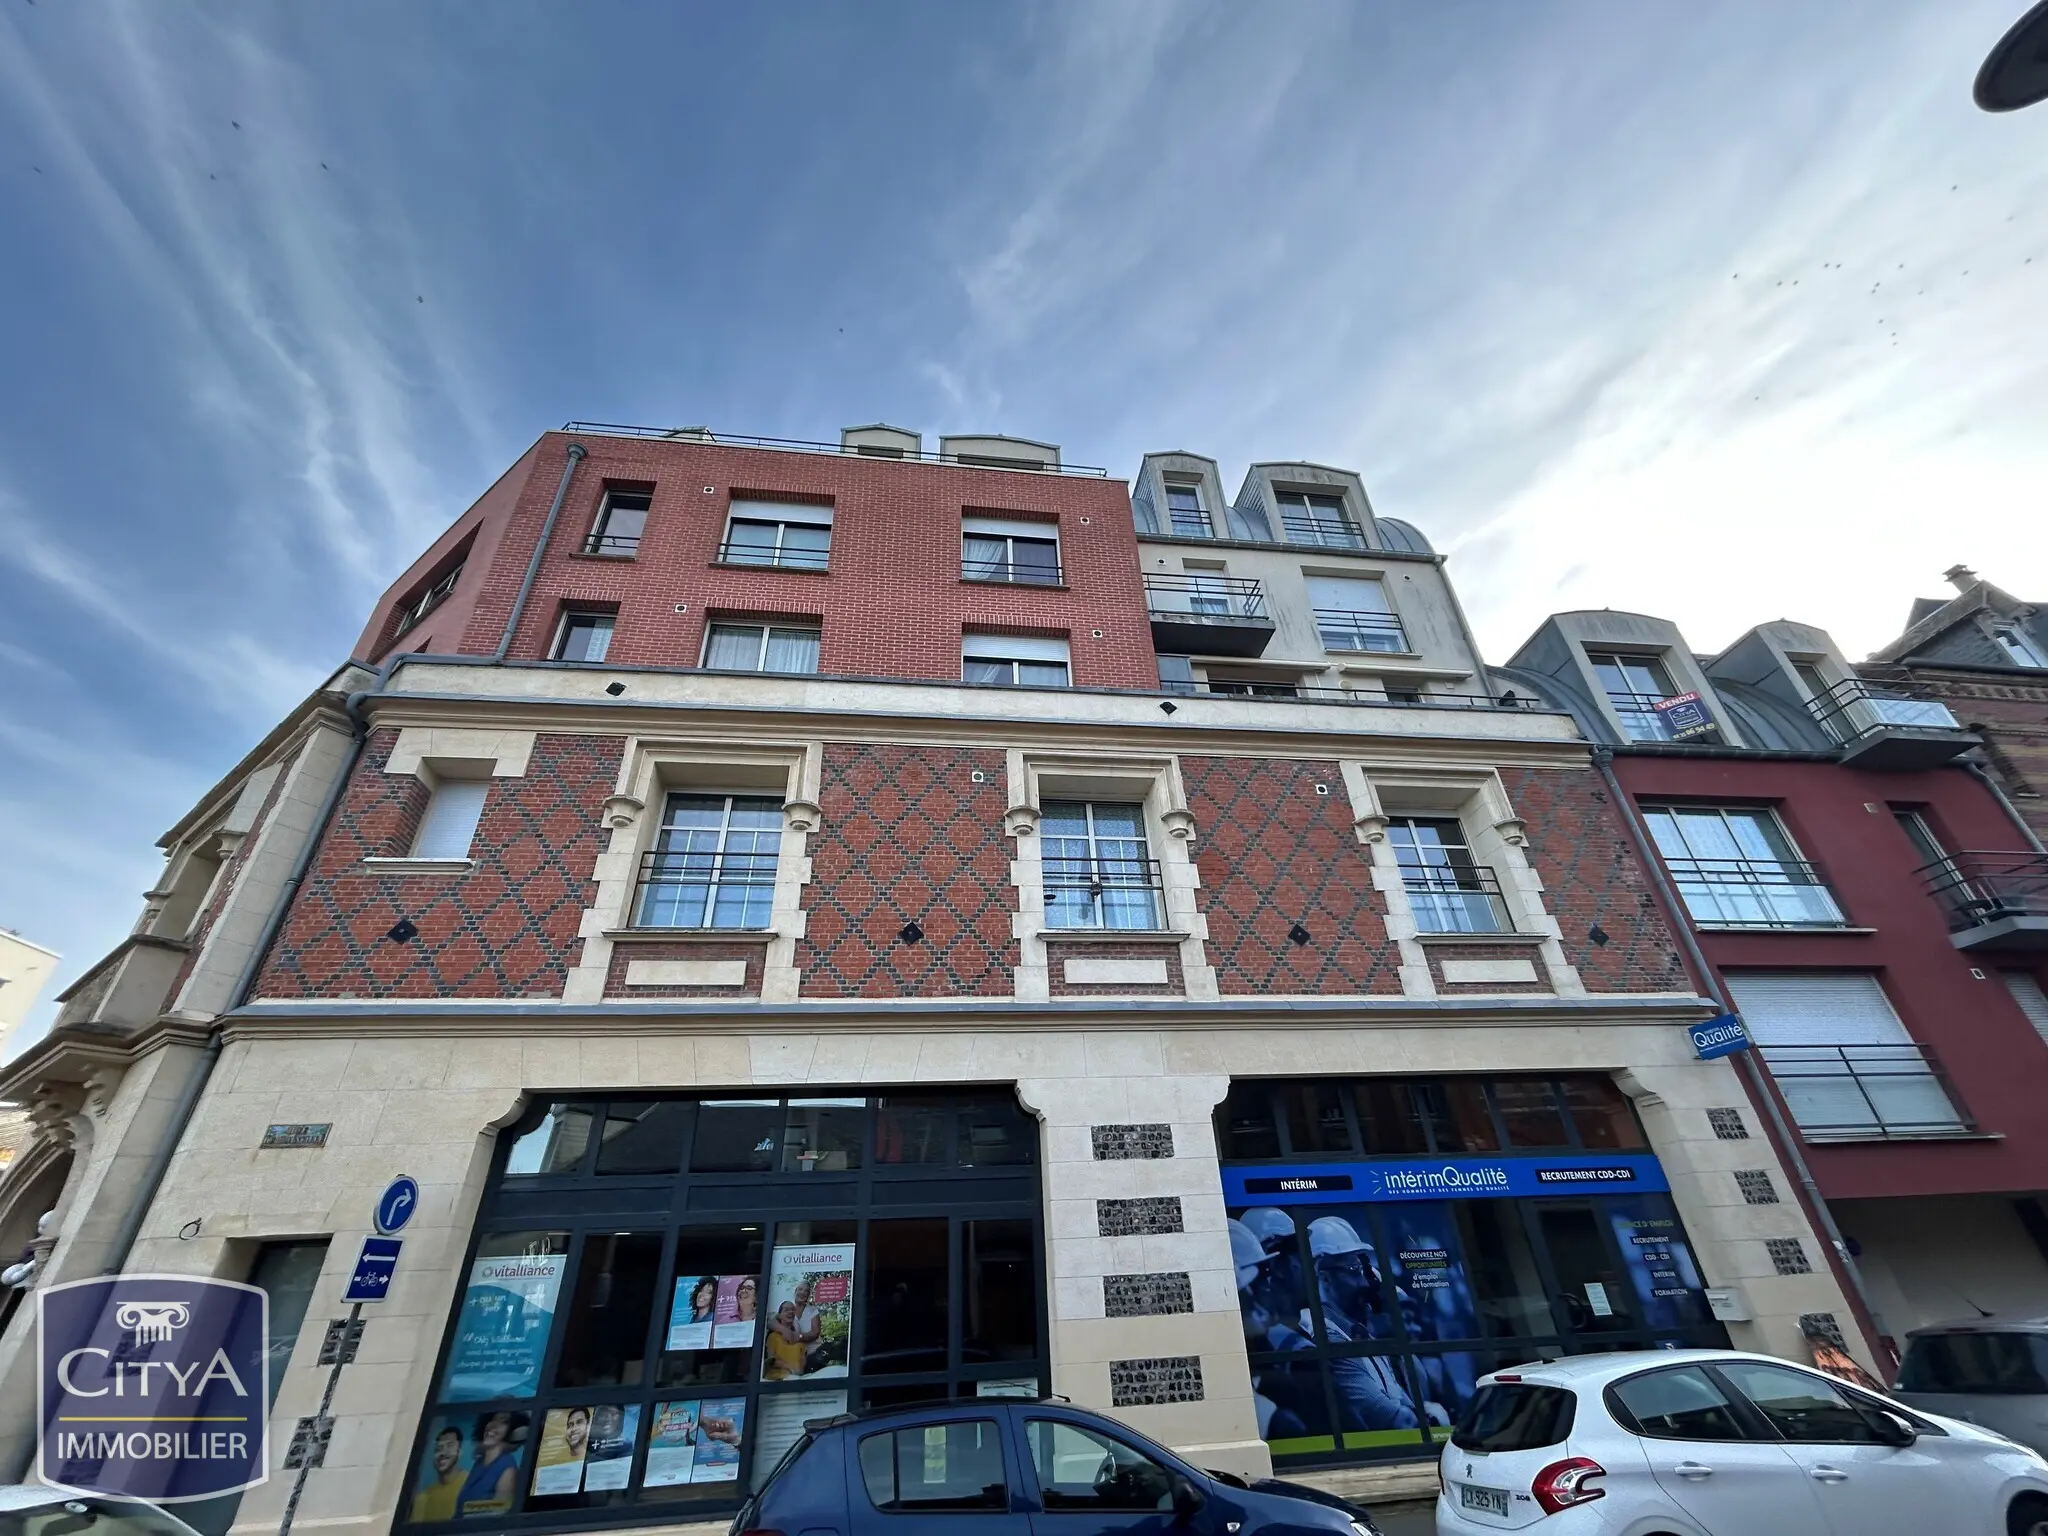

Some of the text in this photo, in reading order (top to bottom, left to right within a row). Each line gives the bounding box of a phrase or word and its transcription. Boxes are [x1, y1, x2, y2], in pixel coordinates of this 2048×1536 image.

[1658, 693, 1696, 709] VENDU
[1693, 1022, 1743, 1047] Qualité
[1384, 1166, 1508, 1189] intérimQualité
[1540, 1164, 1631, 1181] RECRUTEMENT CDD-CDI
[1280, 1178, 1318, 1190] INTÉRIM
[792, 1252, 842, 1264] vitalliance
[494, 1264, 556, 1278] vitalliance
